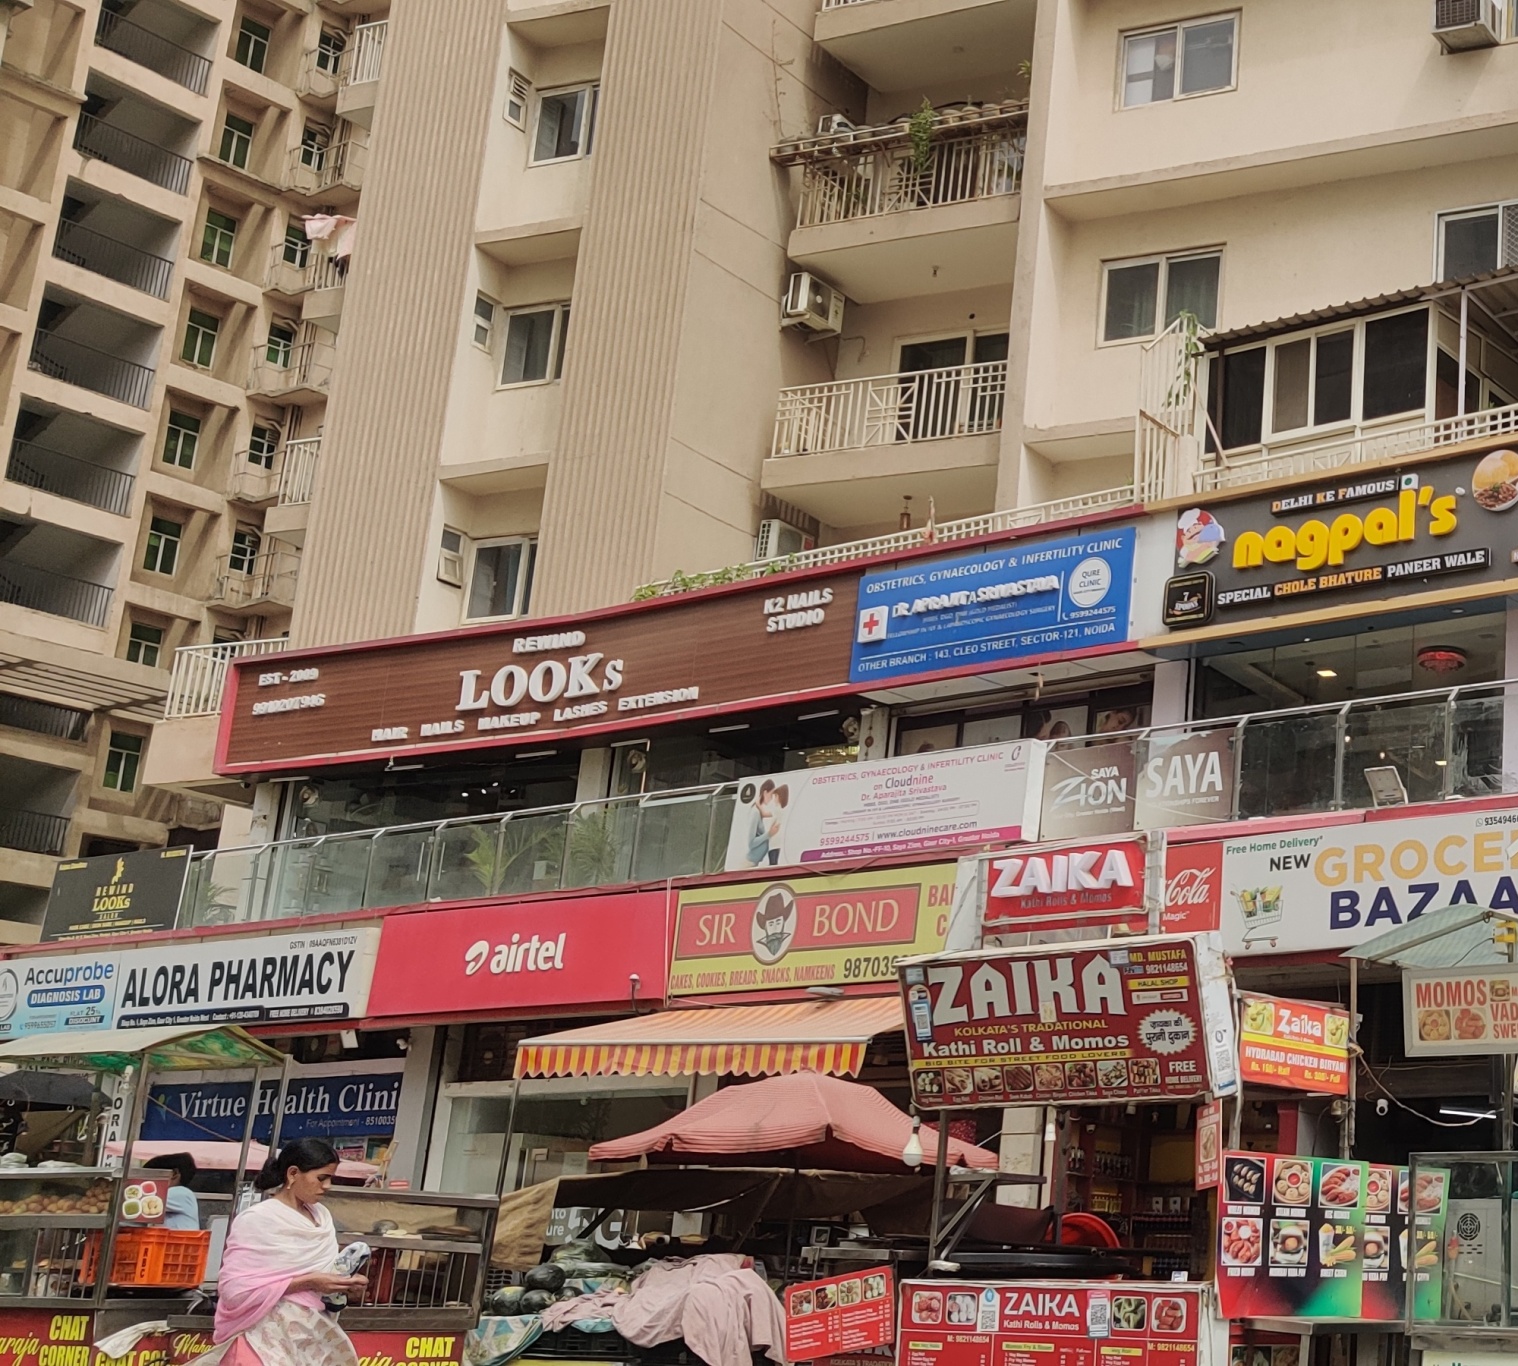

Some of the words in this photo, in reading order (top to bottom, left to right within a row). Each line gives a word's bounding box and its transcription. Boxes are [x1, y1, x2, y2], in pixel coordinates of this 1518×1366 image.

[1272, 493, 1313, 513] DELHI
[1316, 489, 1335, 504] KE
[1338, 480, 1395, 501] FAMOUS
[1233, 485, 1458, 571] nagpal's
[866, 573, 926, 594] OBSTETRICS,
[929, 558, 1006, 582] GYNAECOLOGY
[1008, 557, 1017, 567] &
[1022, 544, 1084, 565] INFERTILITY
[1087, 537, 1123, 553] CLINIC
[1082, 568, 1101, 578] QURE
[1217, 586, 1271, 605] SPECIAL
[1274, 577, 1317, 597] CHOLE
[1319, 567, 1382, 590] BHATURE
[1387, 556, 1441, 578] PANEER
[1445, 549, 1485, 568] WALE
[1079, 577, 1102, 587] CLINIC
[764, 596, 783, 615] K2
[787, 588, 834, 611] NAILS
[766, 608, 824, 632] STUDIO
[513, 630, 586, 654] REWIND
[858, 660, 888, 673] OTHER
[889, 653, 927, 670] BRANCH
[953, 643, 979, 657] CLEO
[980, 638, 1018, 653] STREET,
[1084, 622, 1116, 636] NOIDA
[371, 726, 409, 741] HAIR
[420, 720, 465, 736] NAILS
[477, 712, 541, 730] MAKEUP
[553, 701, 608, 722] LASHES
[618, 686, 699, 711] EXTENSION
[812, 771, 859, 785] OBSTETRICS,
[861, 764, 919, 781] GYNAECOLOGY
[927, 756, 976, 770] INFERTILITY
[977, 751, 1004, 762] CLINIC
[1091, 766, 1119, 779] SAYA
[1145, 751, 1223, 799] SAYA
[873, 783, 883, 791] on
[885, 774, 934, 789] Cloudnine
[873, 788, 907, 802] Aparajita
[908, 783, 947, 796] Srivastava
[1050, 776, 1127, 812] ZION
[820, 832, 870, 847] 9599244575
[876, 820, 978, 841] www.cloudninecare.com
[1226, 845, 1247, 855] Free
[1249, 842, 1277, 853] Home
[990, 849, 1134, 898] ZAIKA
[1269, 853, 1311, 872] NEW
[95, 883, 134, 897] REWIND
[1020, 896, 1042, 908] Kathi
[696, 913, 737, 946] SIR
[812, 898, 899, 938] BOND
[489, 933, 566, 974] airtel
[1148, 949, 1187, 961] MUSTAFA
[24, 961, 114, 986] Accuprobe
[121, 963, 199, 1008] ALORA
[208, 950, 356, 1003] PHARMACY
[670, 974, 693, 990] CAKES,
[696, 971, 727, 988] COOKIES,
[729, 969, 758, 986] BREADS,
[761, 967, 791, 984] SNACKS,
[794, 964, 835, 981] NAMKEENS
[1161, 978, 1179, 986] SHOP
[30, 990, 80, 1004] DIAGNOSIS
[82, 988, 101, 1001] LAB
[927, 953, 1129, 1026] ZAIKA
[1416, 979, 1487, 1008] MOMOS
[954, 1025, 1018, 1037] KOLKATA'S
[1022, 1020, 1108, 1033] TRADATIONAL
[1277, 1008, 1322, 1037] Zaika
[923, 1042, 976, 1057] Kathi
[983, 1038, 1021, 1054] Roll
[1029, 1036, 1045, 1051] &
[1052, 1034, 1129, 1050] Momos
[1145, 1029, 1166, 1045] पुरानी
[1168, 1030, 1190, 1044] दुकान
[1000, 1055, 1041, 1063] STREET
[1081, 1050, 1127, 1058] LOVERS
[1169, 1060, 1197, 1073] FREE
[1245, 1045, 1286, 1063] HYDRABAD
[1286, 1052, 1318, 1068] CHICKEN
[179, 1090, 246, 1118] Virtue
[306, 1119, 318, 1127] For
[1003, 1292, 1080, 1317] ZAIKA
[49, 1315, 89, 1342] CHAT
[1003, 1320, 1022, 1329] Kathi
[1024, 1320, 1042, 1329] Rolls
[39, 1345, 90, 1366] CORNER
[405, 1337, 455, 1358] CHAT
